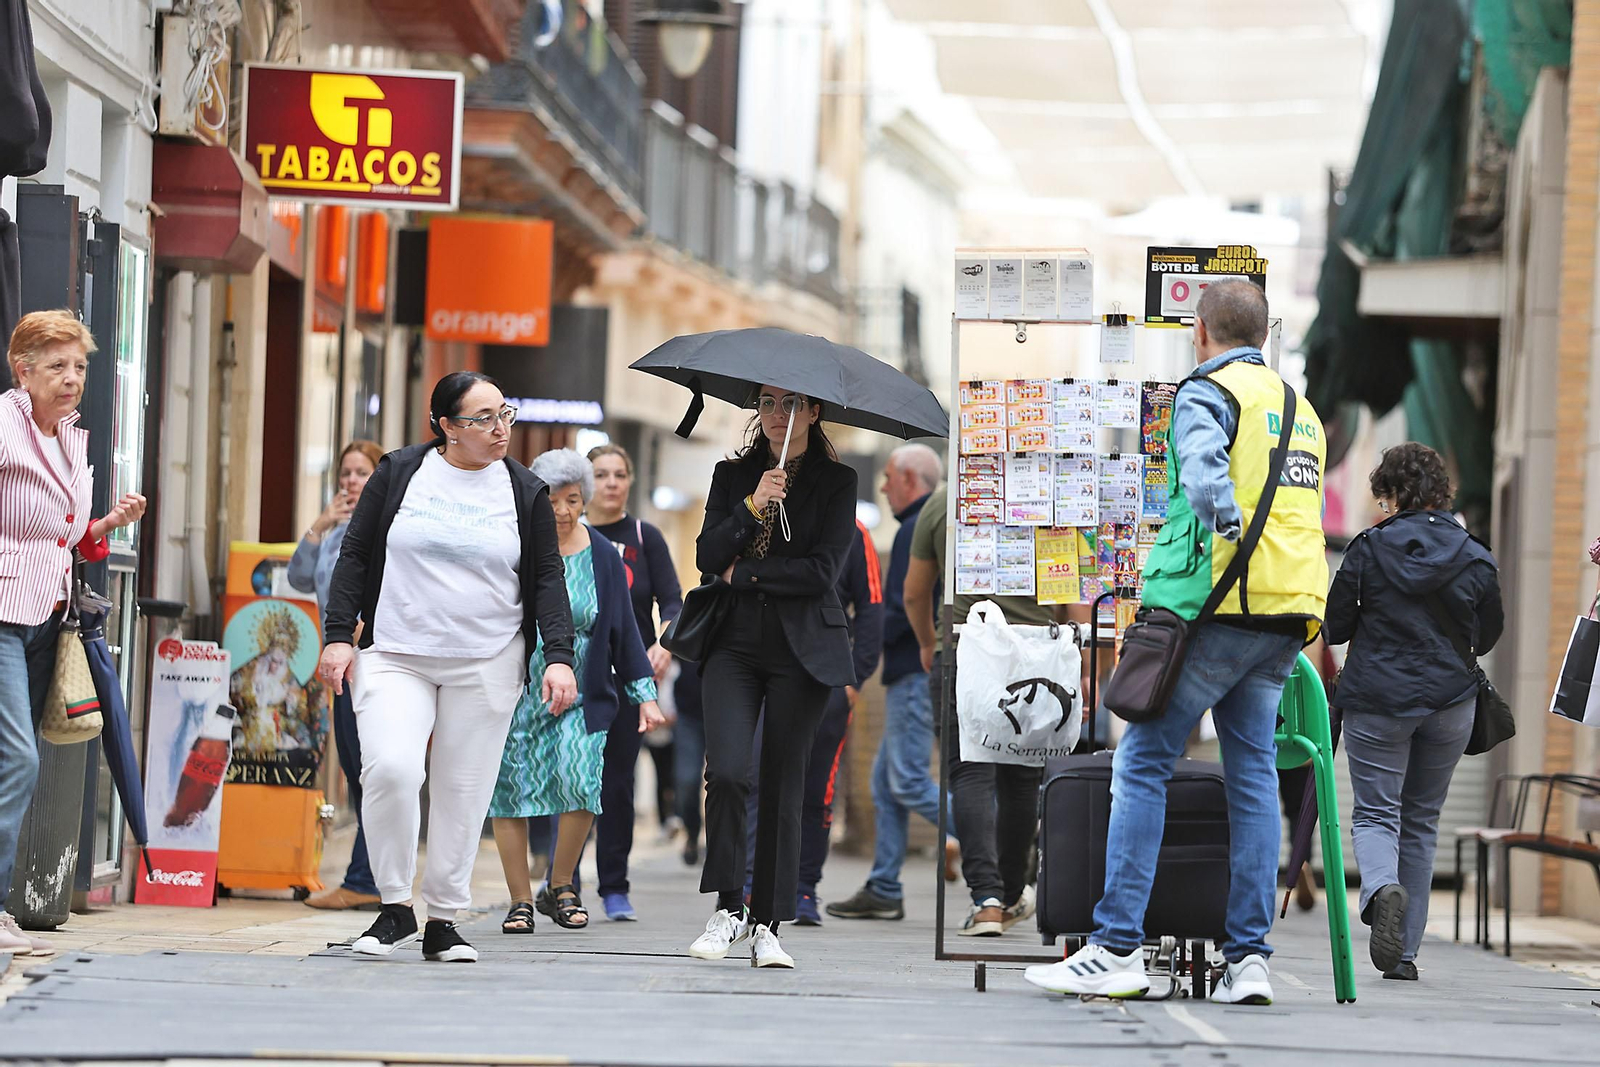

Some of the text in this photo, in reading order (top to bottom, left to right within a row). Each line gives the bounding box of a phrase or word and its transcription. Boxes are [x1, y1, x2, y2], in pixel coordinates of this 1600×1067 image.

[256, 143, 442, 188] TABACOS
[1216, 245, 1252, 259] EURO
[1151, 263, 1200, 273] BOTE DE
[1203, 258, 1264, 274] JACKPOT
[431, 308, 537, 342] orange
[1286, 455, 1310, 467] grupo
[1048, 563, 1070, 574] x10
[160, 674, 181, 682] TAKE
[982, 734, 1002, 752] La
[146, 868, 207, 888] Coca-Cola
